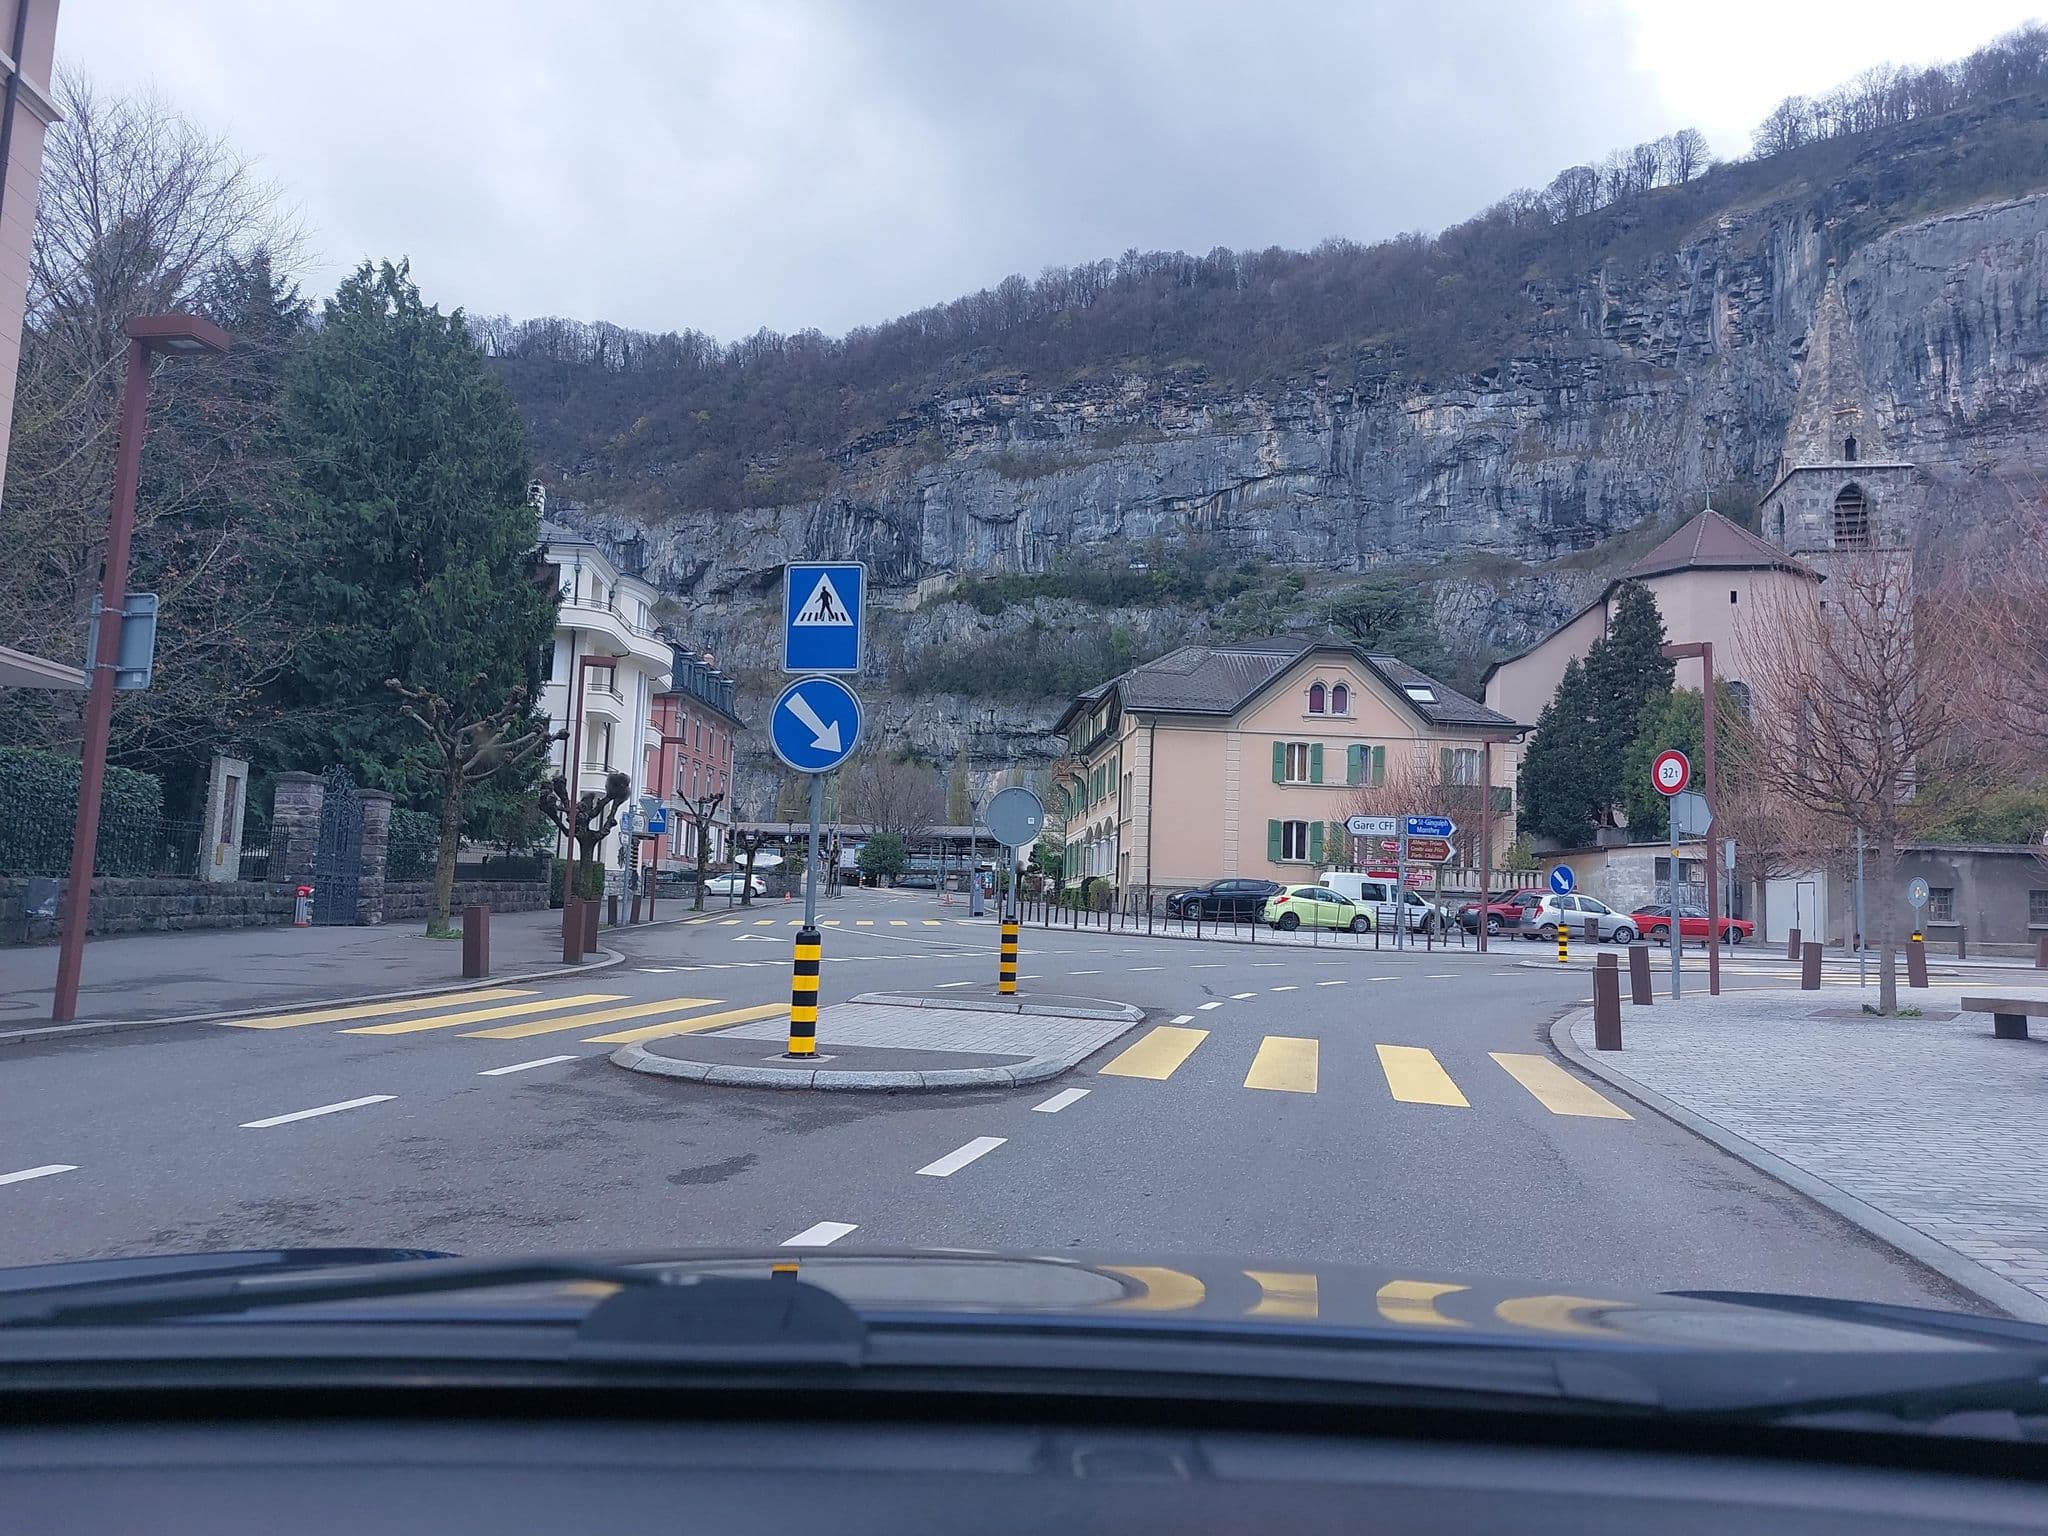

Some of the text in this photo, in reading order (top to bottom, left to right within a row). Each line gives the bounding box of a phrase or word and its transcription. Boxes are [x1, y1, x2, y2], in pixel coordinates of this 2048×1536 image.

[1353, 820, 1394, 831] Gare CFF
[1418, 819, 1449, 827] St-Gingolph
[1416, 826, 1440, 835] Monthey
